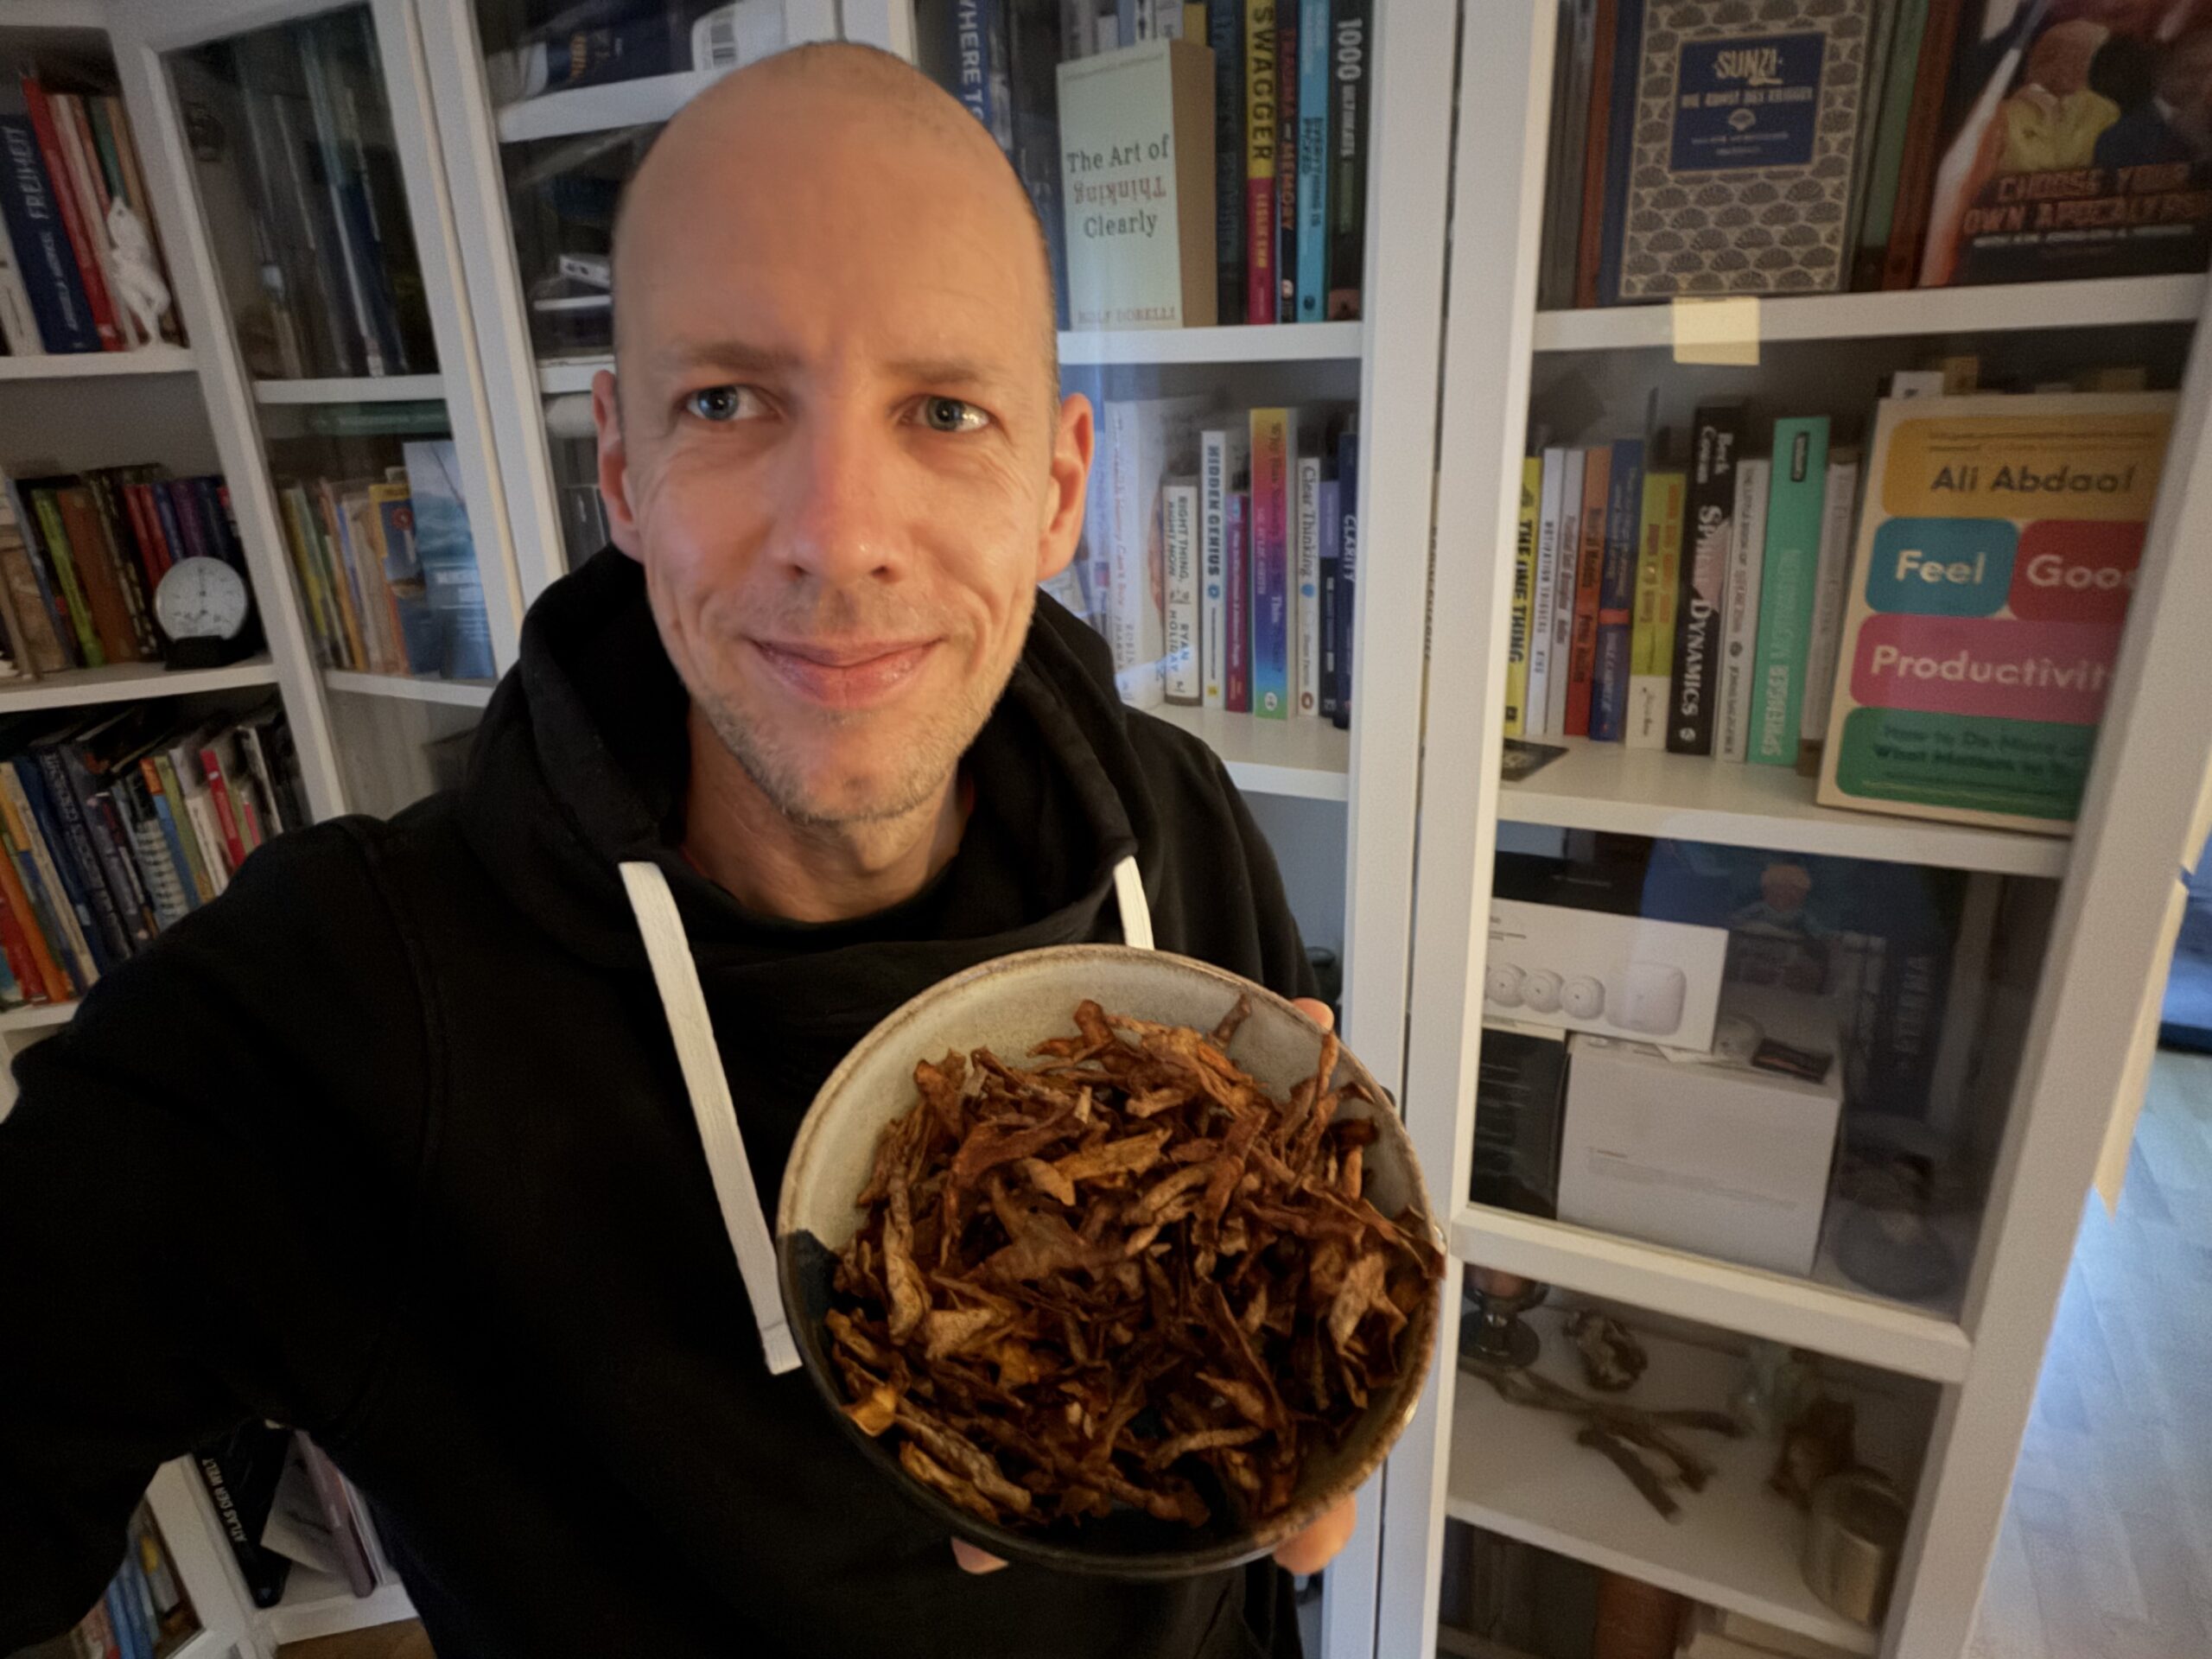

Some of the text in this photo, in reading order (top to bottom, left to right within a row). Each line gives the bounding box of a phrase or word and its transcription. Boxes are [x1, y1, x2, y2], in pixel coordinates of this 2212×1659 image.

[1337, 18, 1363, 81] 1000
[1252, 5, 1274, 162] SWAGGER
[1066, 134, 1171, 174] The Art of
[1073, 176, 1166, 205] Thinking
[1084, 210, 1158, 238] Clearly
[1930, 461, 2139, 494] Ali Abdaal
[1178, 496, 1188, 536] RIGHT
[1207, 445, 1220, 576] HIDDEN GENIUS
[1299, 466, 1317, 577] Clear Thinking
[1344, 514, 1357, 582] CLARITY
[1517, 519, 1533, 557] THE
[1895, 549, 1987, 585] Feel
[1271, 594, 1283, 623] This
[1168, 610, 1179, 671] HOLIDAY
[1179, 623, 1190, 660] RYAN
[1510, 606, 1528, 664] THING
[1681, 598, 1713, 717] DYNAMICS
[1870, 645, 2115, 691] Productivit
[223, 1509, 248, 1543] ATLAS
